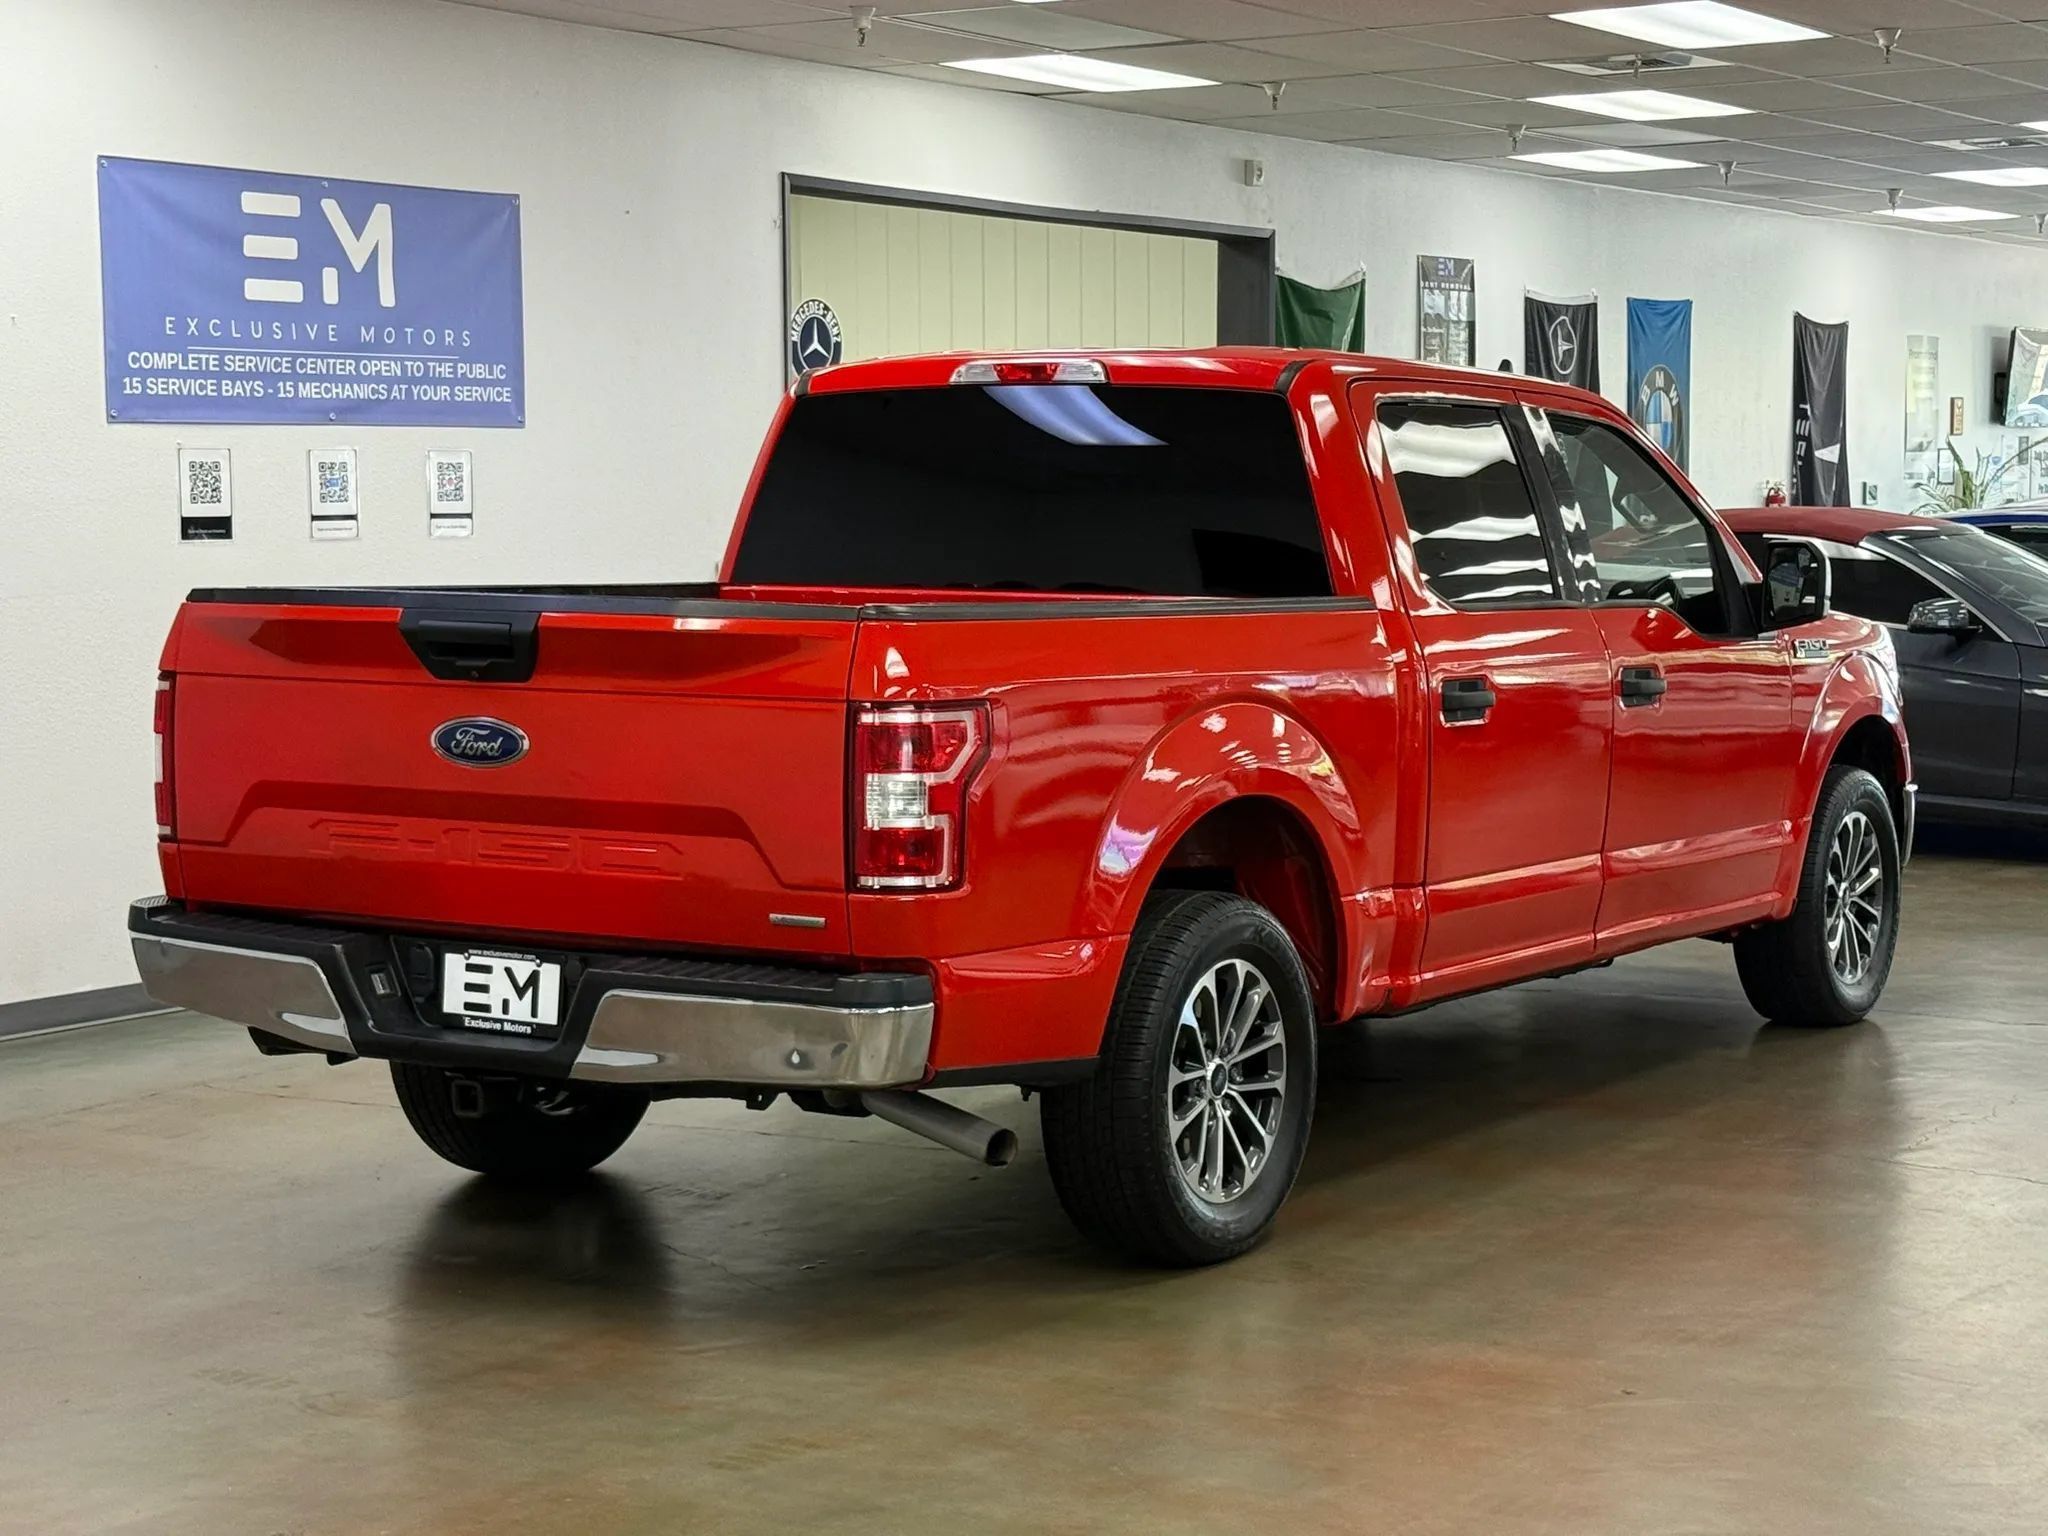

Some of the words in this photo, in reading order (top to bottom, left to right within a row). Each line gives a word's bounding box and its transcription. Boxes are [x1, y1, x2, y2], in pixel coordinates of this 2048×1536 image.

[165, 316, 338, 342] EXCLUSIVE
[360, 325, 471, 347] MOTORS
[127, 351, 220, 371] COMPLETE
[223, 355, 292, 374] SERVICE
[296, 358, 356, 376] CENTER
[359, 360, 401, 377] OPEN
[404, 361, 424, 378] TO
[427, 362, 454, 378] THE
[457, 363, 507, 380] PUBLIC
[122, 376, 142, 394] 15
[146, 378, 218, 396] SERVICE
[221, 380, 264, 398] BAYS
[277, 381, 295, 398] 15
[298, 382, 388, 400] MECHANICS
[390, 384, 408, 401] AT
[410, 384, 451, 401] YOUR
[454, 387, 512, 402] SERVICE
[451, 727, 504, 756] Ford
[464, 1017, 502, 1031] Exclusive
[503, 1021, 532, 1034] Motors
